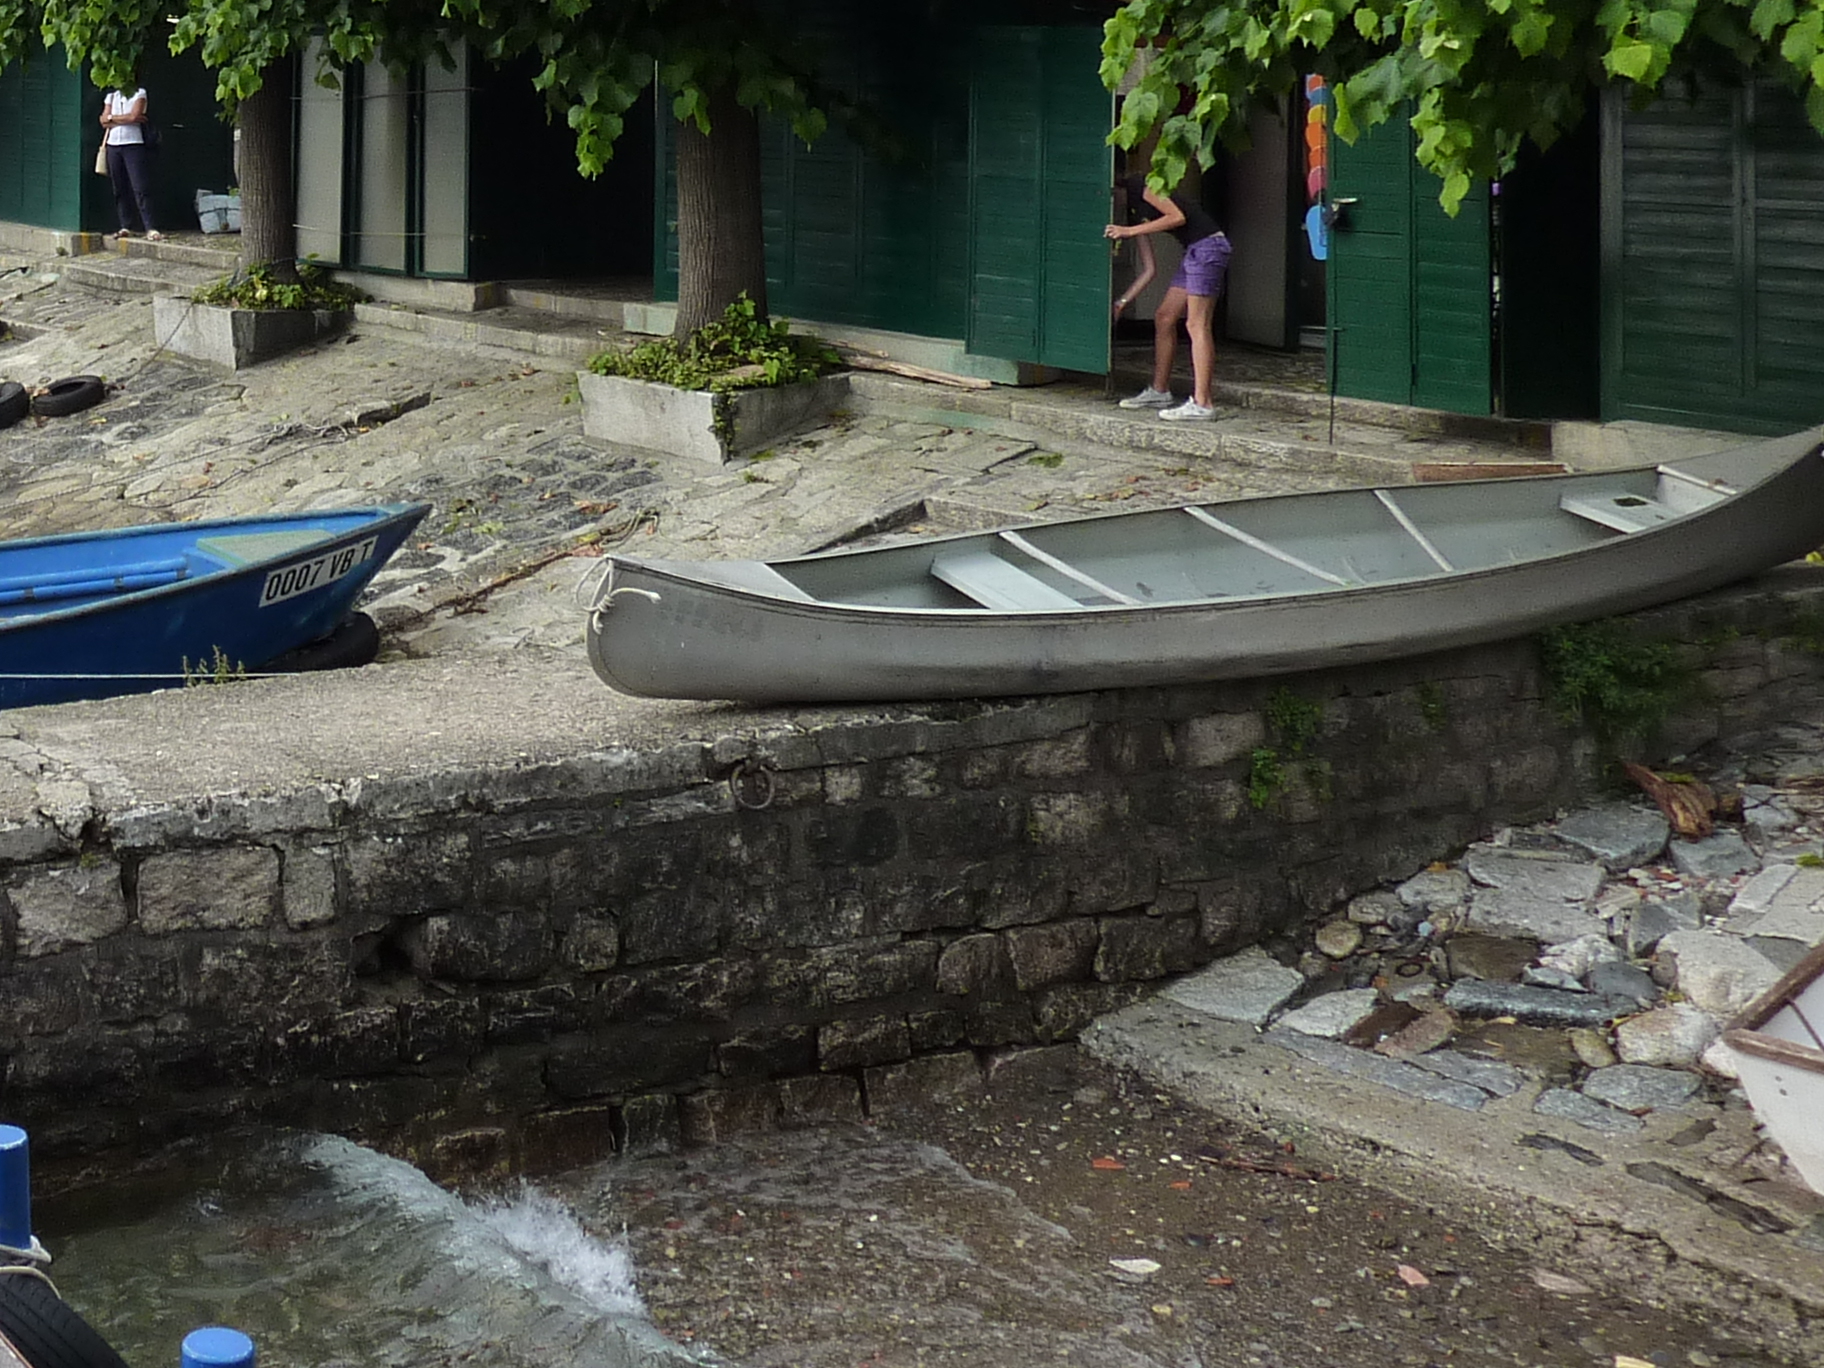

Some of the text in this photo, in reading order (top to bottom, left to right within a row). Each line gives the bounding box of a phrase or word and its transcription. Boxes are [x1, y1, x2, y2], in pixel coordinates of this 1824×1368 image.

[265, 539, 374, 602] 0007 VB T
